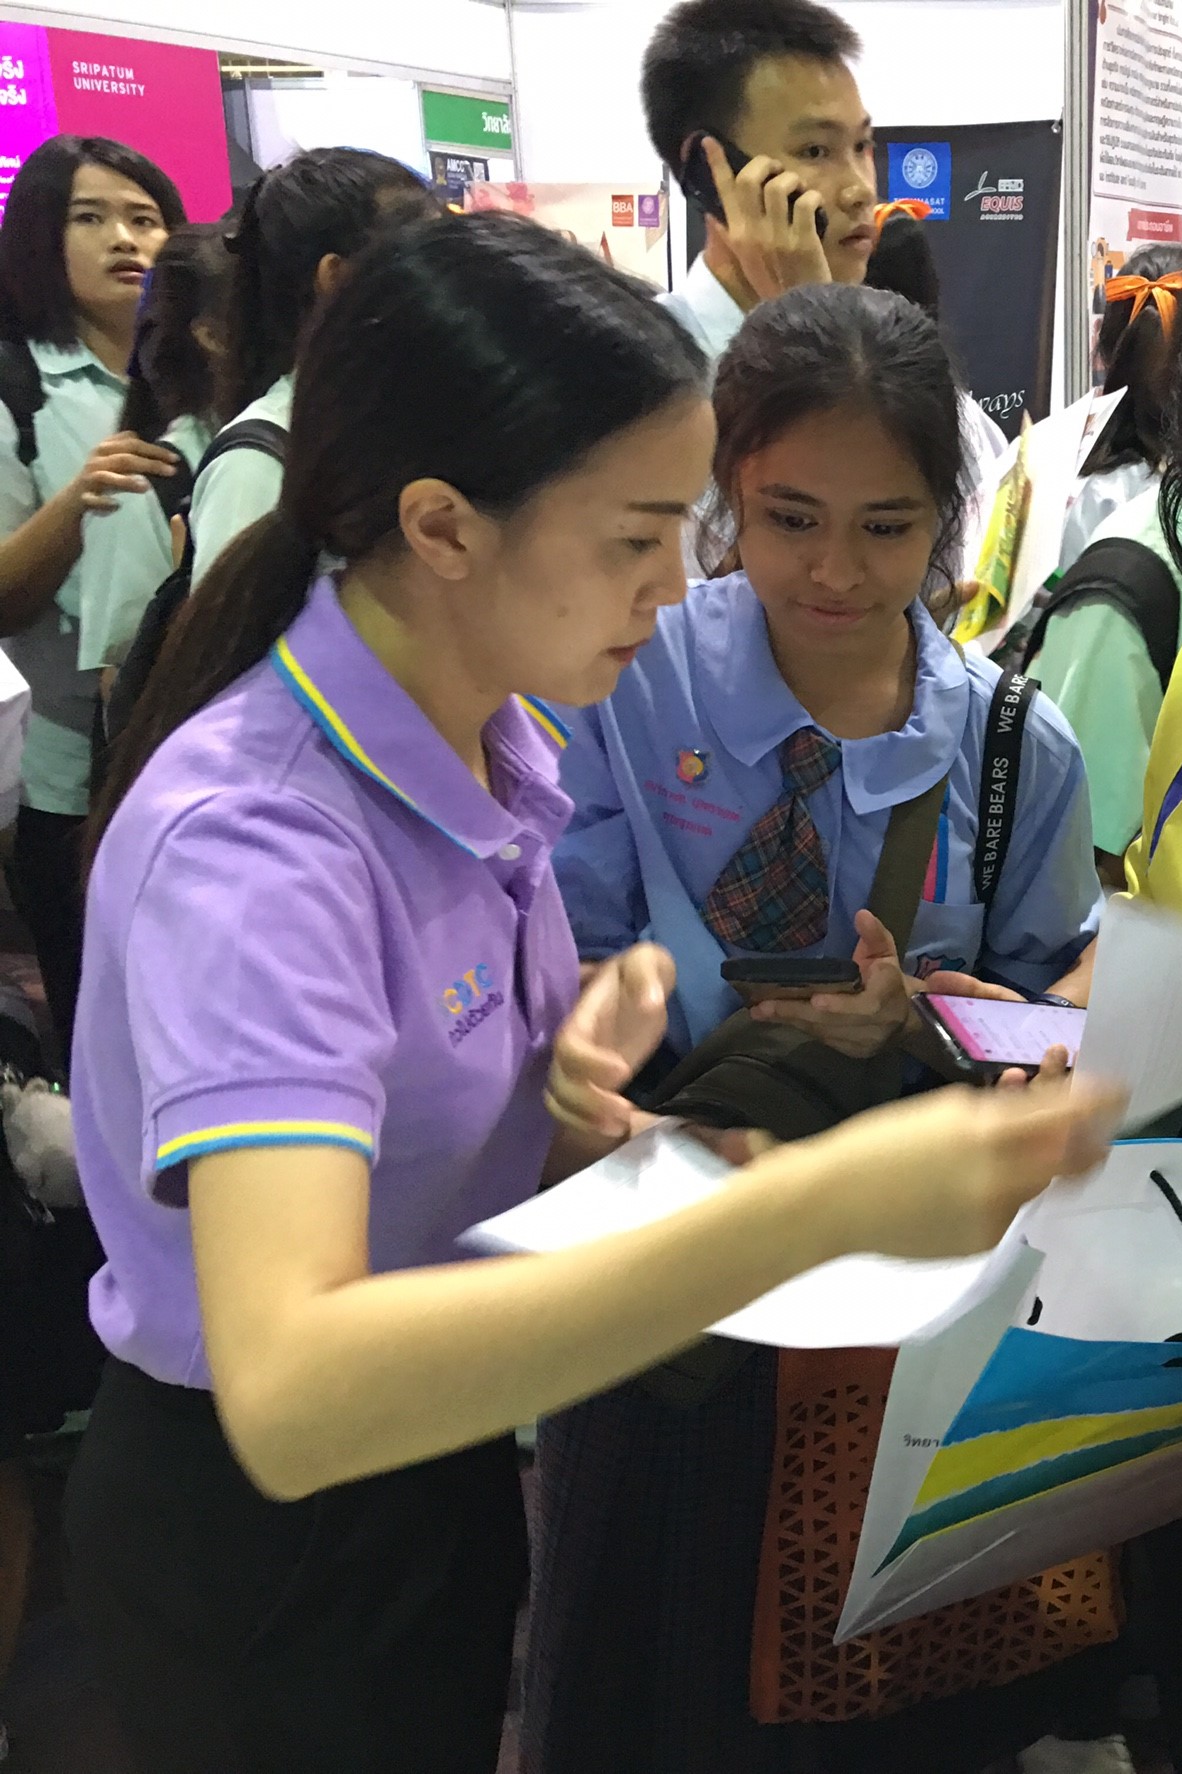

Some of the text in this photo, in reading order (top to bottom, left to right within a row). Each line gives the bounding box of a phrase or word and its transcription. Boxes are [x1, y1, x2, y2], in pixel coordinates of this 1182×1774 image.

[72, 61, 135, 80] SRIPATUM
[74, 77, 145, 96] UNIVERSITY
[612, 201, 634, 213] BBA
[980, 196, 1024, 213] EQUIS
[997, 705, 1018, 734] WE
[981, 756, 1010, 891] WE BARE BEARS
[443, 962, 493, 1015] CDTC
